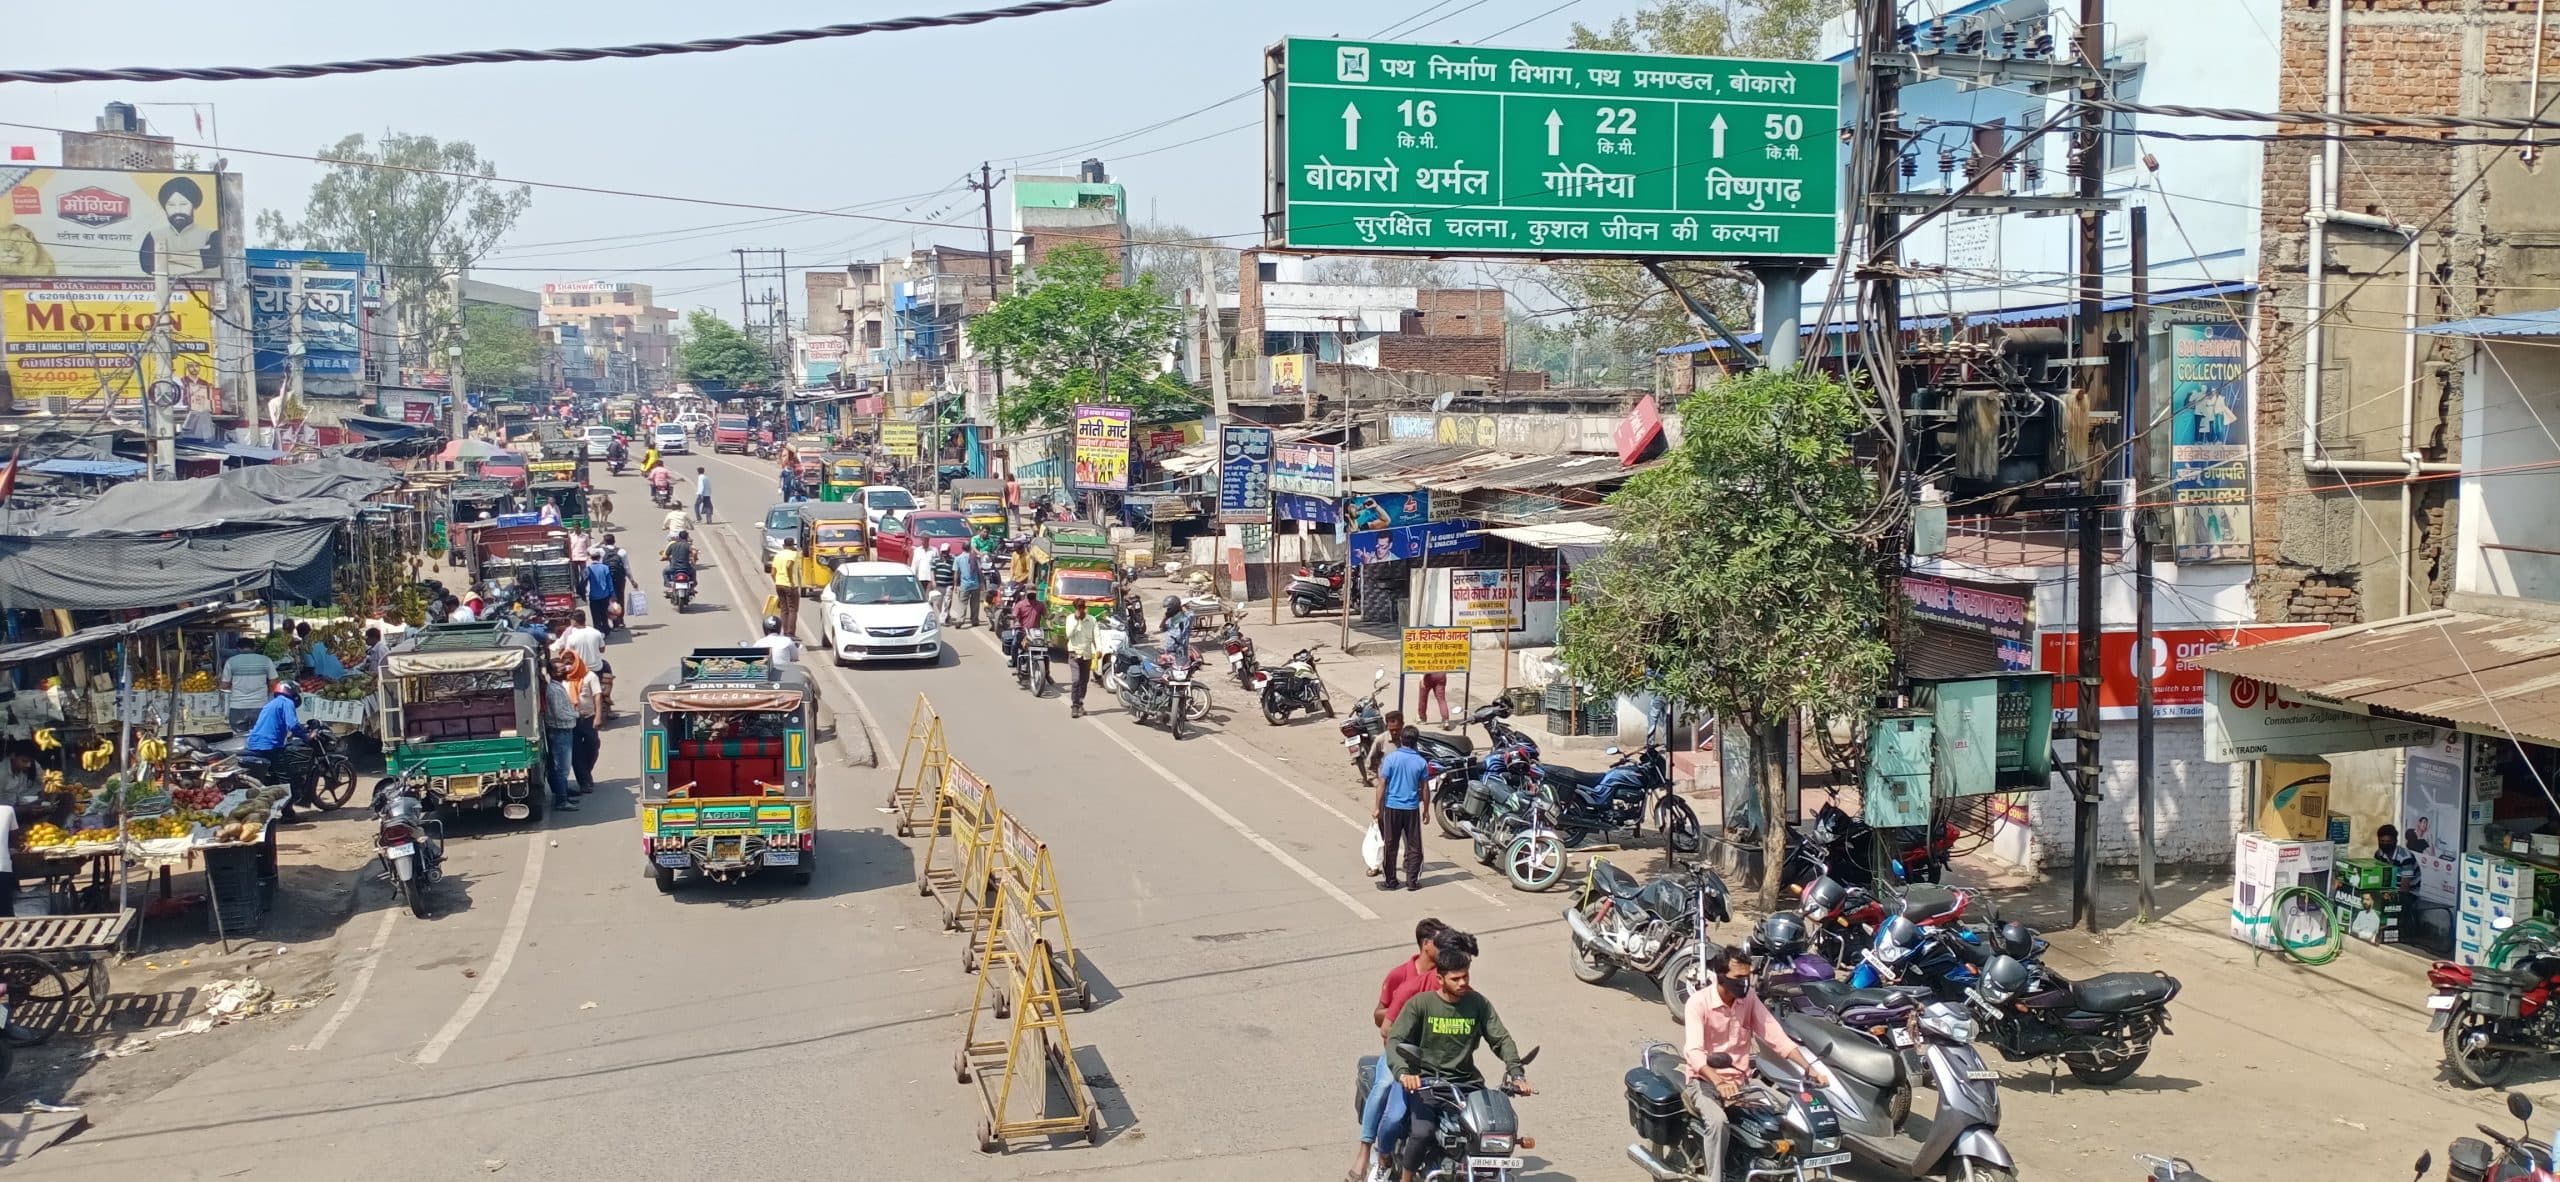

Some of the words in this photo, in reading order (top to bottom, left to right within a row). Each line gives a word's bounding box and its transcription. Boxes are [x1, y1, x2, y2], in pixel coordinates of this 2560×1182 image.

[1380, 58, 1416, 78] पथ
[1428, 54, 1497, 81] निर्माण
[1587, 68, 1621, 87] पथ
[1728, 68, 1796, 94] बोकारो
[1397, 99, 1437, 127] 16
[1596, 108, 1637, 135] 22
[1764, 114, 1803, 140] 50
[1397, 131, 1438, 149] कि.मी.
[1597, 138, 1636, 155] कि.मी.
[1765, 144, 1802, 161] कि.मी.
[1304, 154, 1399, 192] बोकारो
[1416, 160, 1489, 195] थर्मल
[1542, 162, 1636, 198] गोमिया
[1705, 167, 1802, 210] विष्णुगढ़
[64, 195, 124, 213] मोंगिया
[82, 232, 95, 241] का
[1353, 211, 1432, 242] सुरक्षित
[1528, 221, 1588, 245] कुशल
[1600, 215, 1659, 241] जीवन
[1671, 217, 1699, 241] की
[1711, 223, 1779, 242] कल्पना
[53, 281, 85, 290] KOTA'S
[121, 282, 154, 290] RANCH
[26, 303, 182, 332] MOTION
[2177, 340, 2195, 358] OM
[22, 358, 95, 368] ADMISSION
[312, 358, 350, 369] WEAR
[2178, 363, 2242, 381] COLLECTION
[1079, 419, 1104, 437] मोती
[1107, 421, 1128, 438] मार्ट
[1432, 499, 1459, 508] SWEETS
[1951, 585, 2025, 625] वस्त्रालय
[2153, 684, 2179, 693] switch
[2180, 707, 2204, 715] Tradin
[2264, 713, 2308, 726] Connection
[2222, 748, 2228, 757] S
[2236, 745, 2268, 755] TRADING
